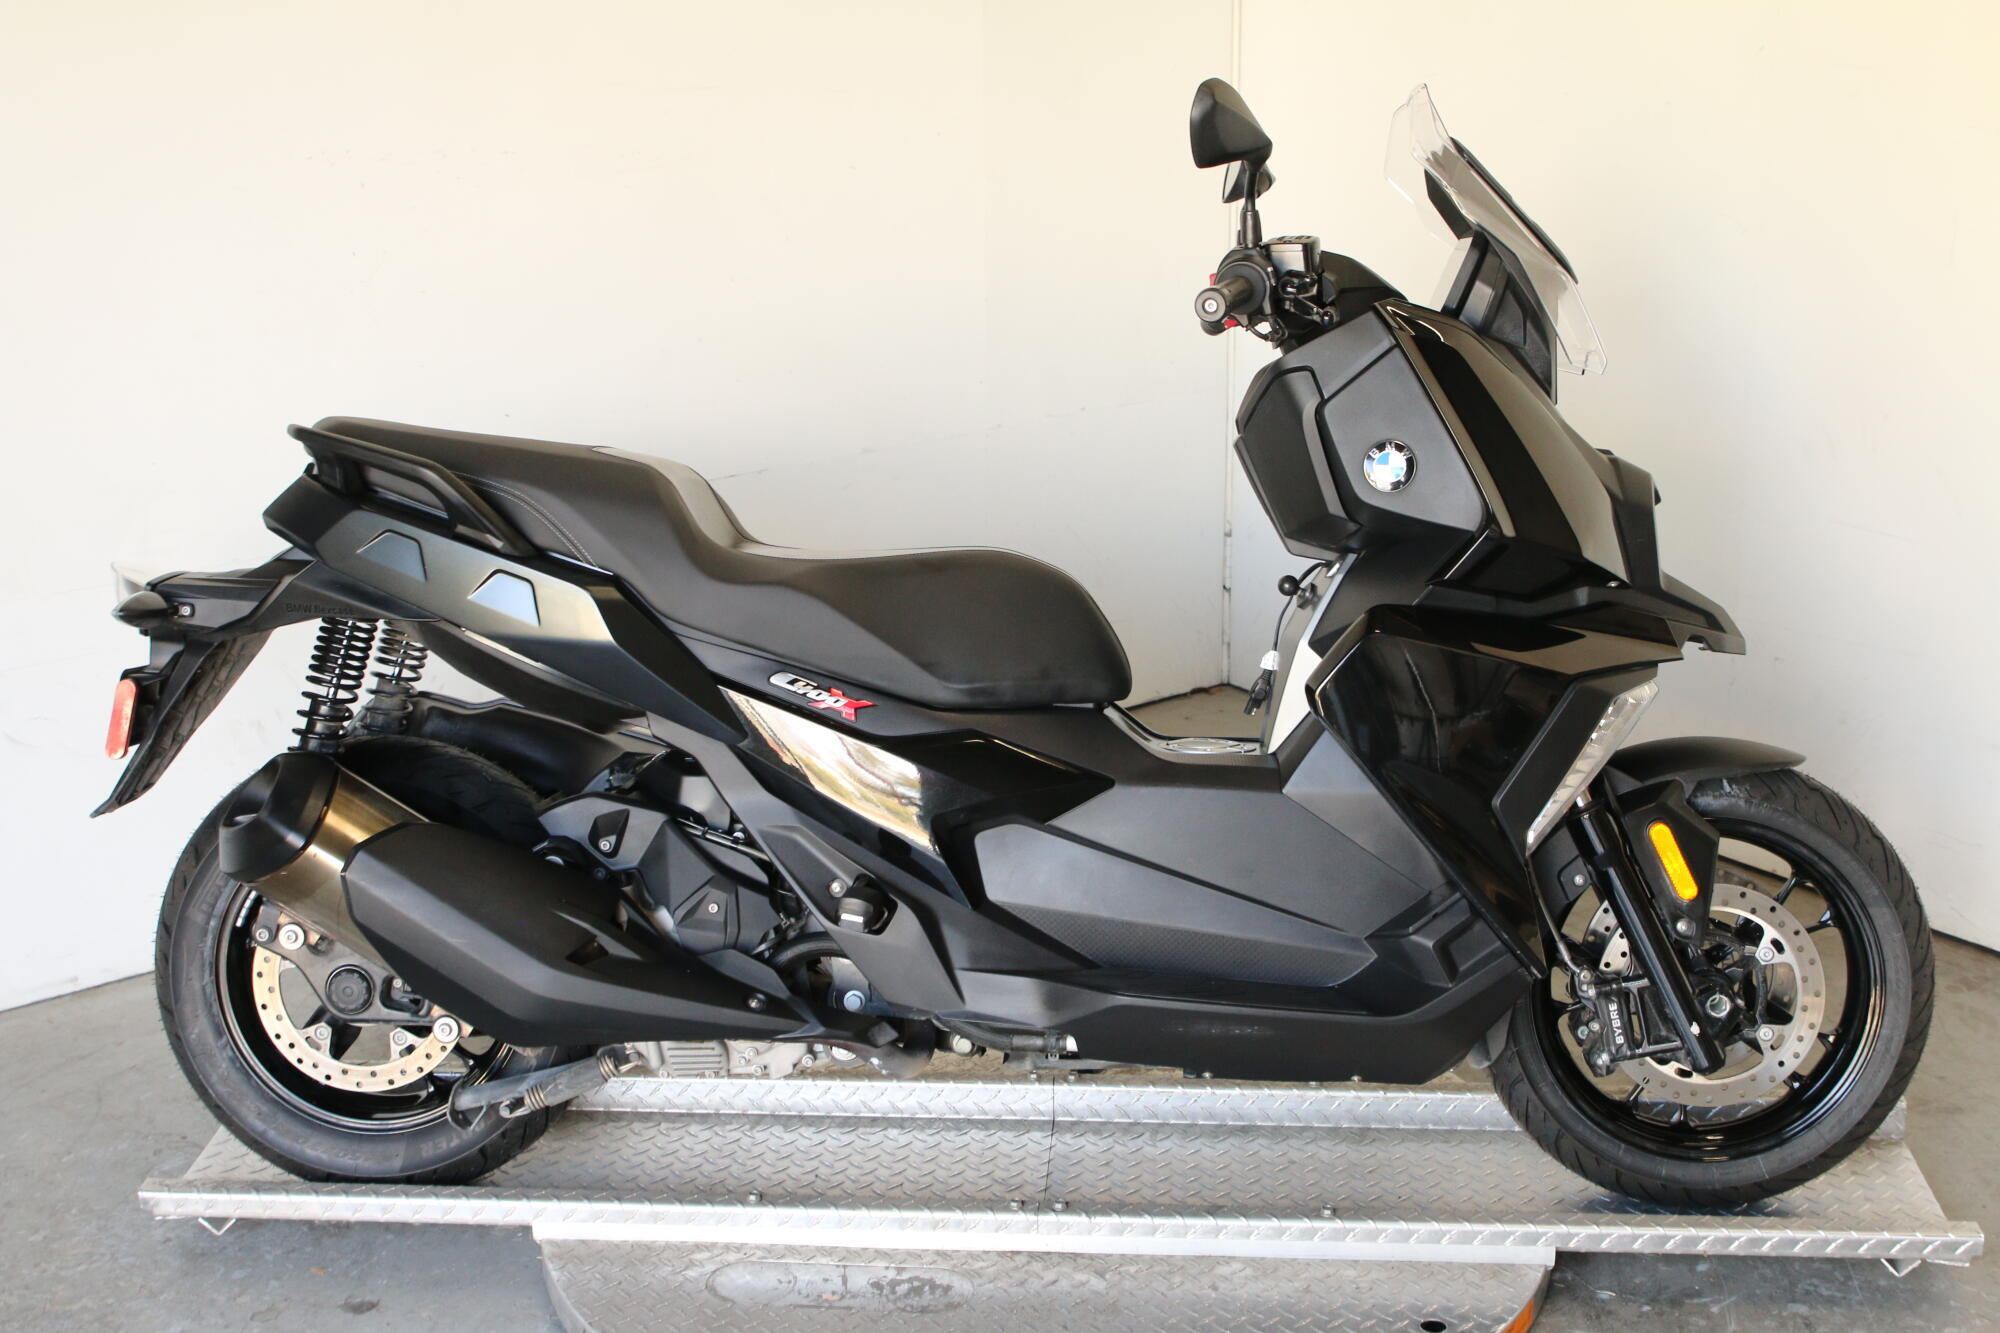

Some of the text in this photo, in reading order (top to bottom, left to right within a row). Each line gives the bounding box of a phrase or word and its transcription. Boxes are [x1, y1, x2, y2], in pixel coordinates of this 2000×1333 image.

[1368, 441, 1413, 459] BMW
[285, 602, 312, 614] BMW
[1608, 1002, 1625, 1045] BYBRE
